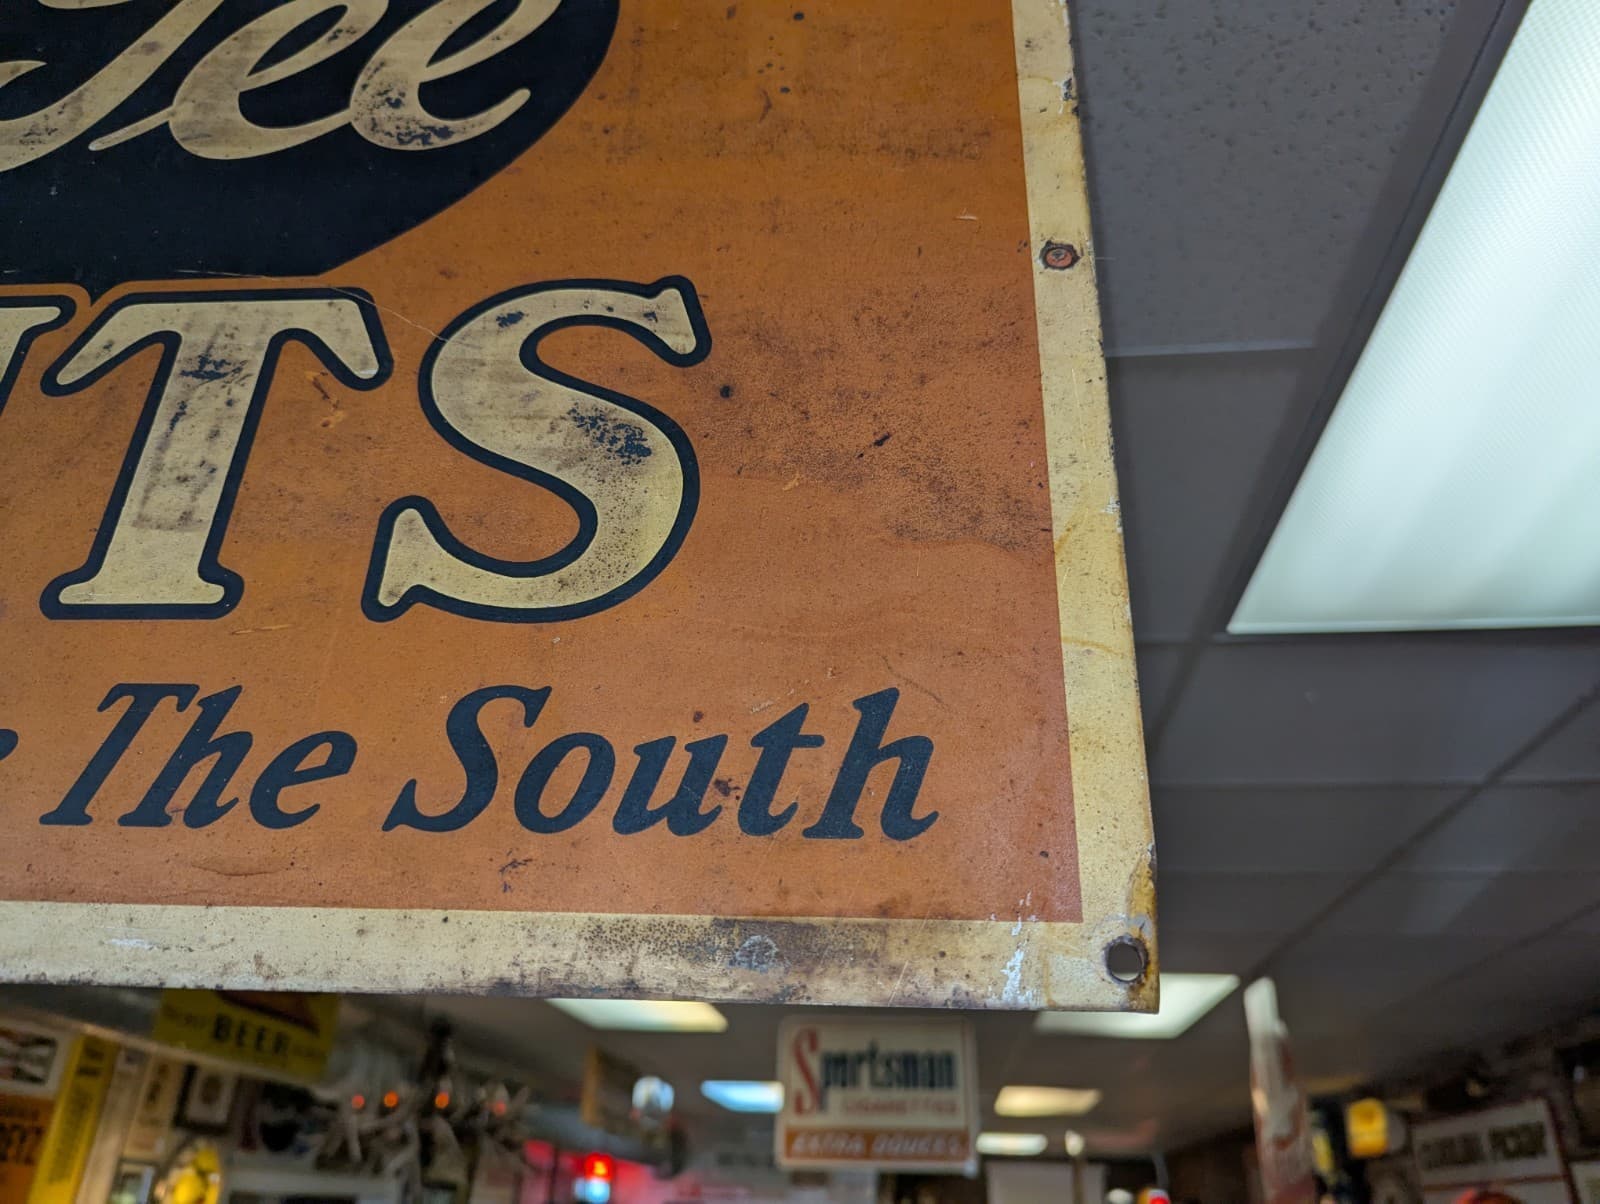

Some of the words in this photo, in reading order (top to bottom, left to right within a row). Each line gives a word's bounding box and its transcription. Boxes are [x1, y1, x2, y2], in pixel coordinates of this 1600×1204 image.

[0, 275, 711, 623] TS
[39, 683, 358, 829] The
[382, 684, 939, 841] South
[213, 1012, 291, 1055] BEER
[791, 1027, 957, 1116] Sportsman
